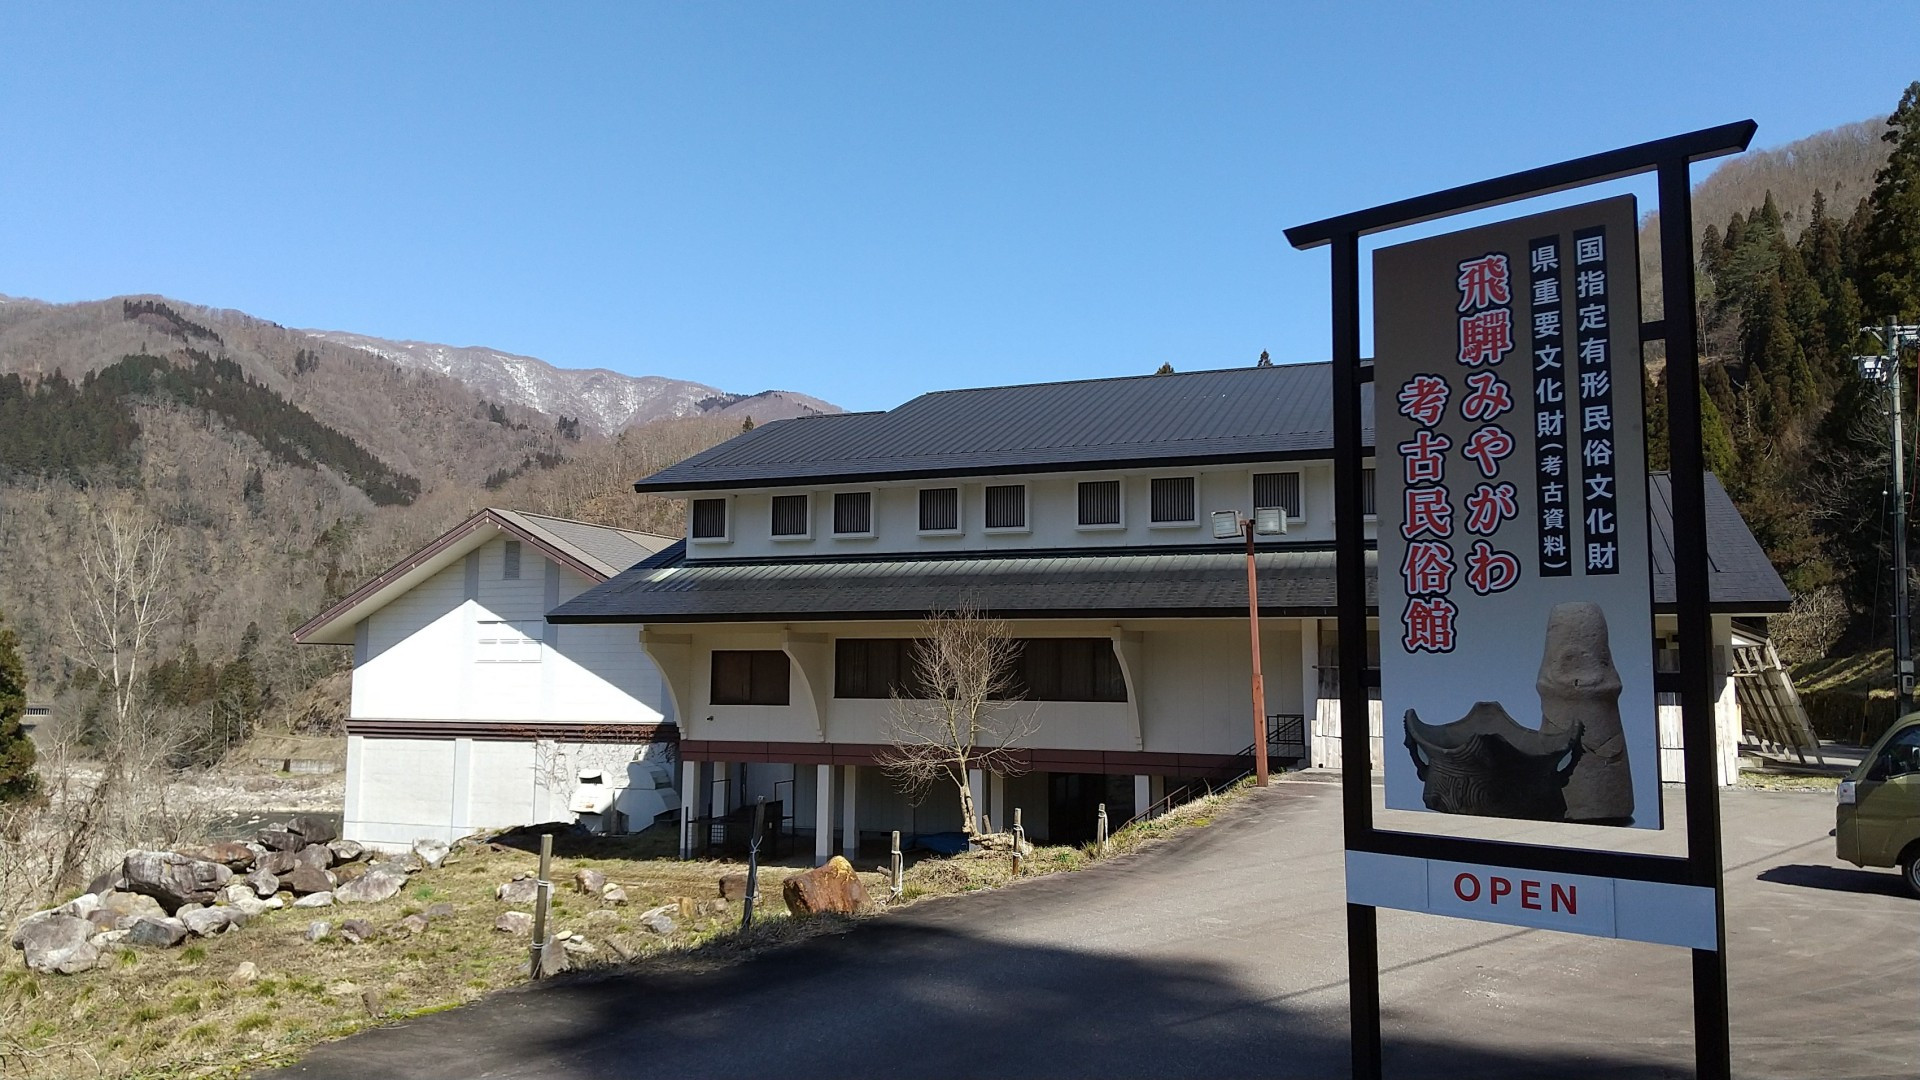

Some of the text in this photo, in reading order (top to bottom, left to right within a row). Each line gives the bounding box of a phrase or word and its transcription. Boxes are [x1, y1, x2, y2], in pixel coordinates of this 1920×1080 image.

[1398, 375, 1456, 653] 考古民俗館
[1576, 236, 1616, 570] 国指定有形民俗文化財
[1454, 872, 1577, 914] OPEN
